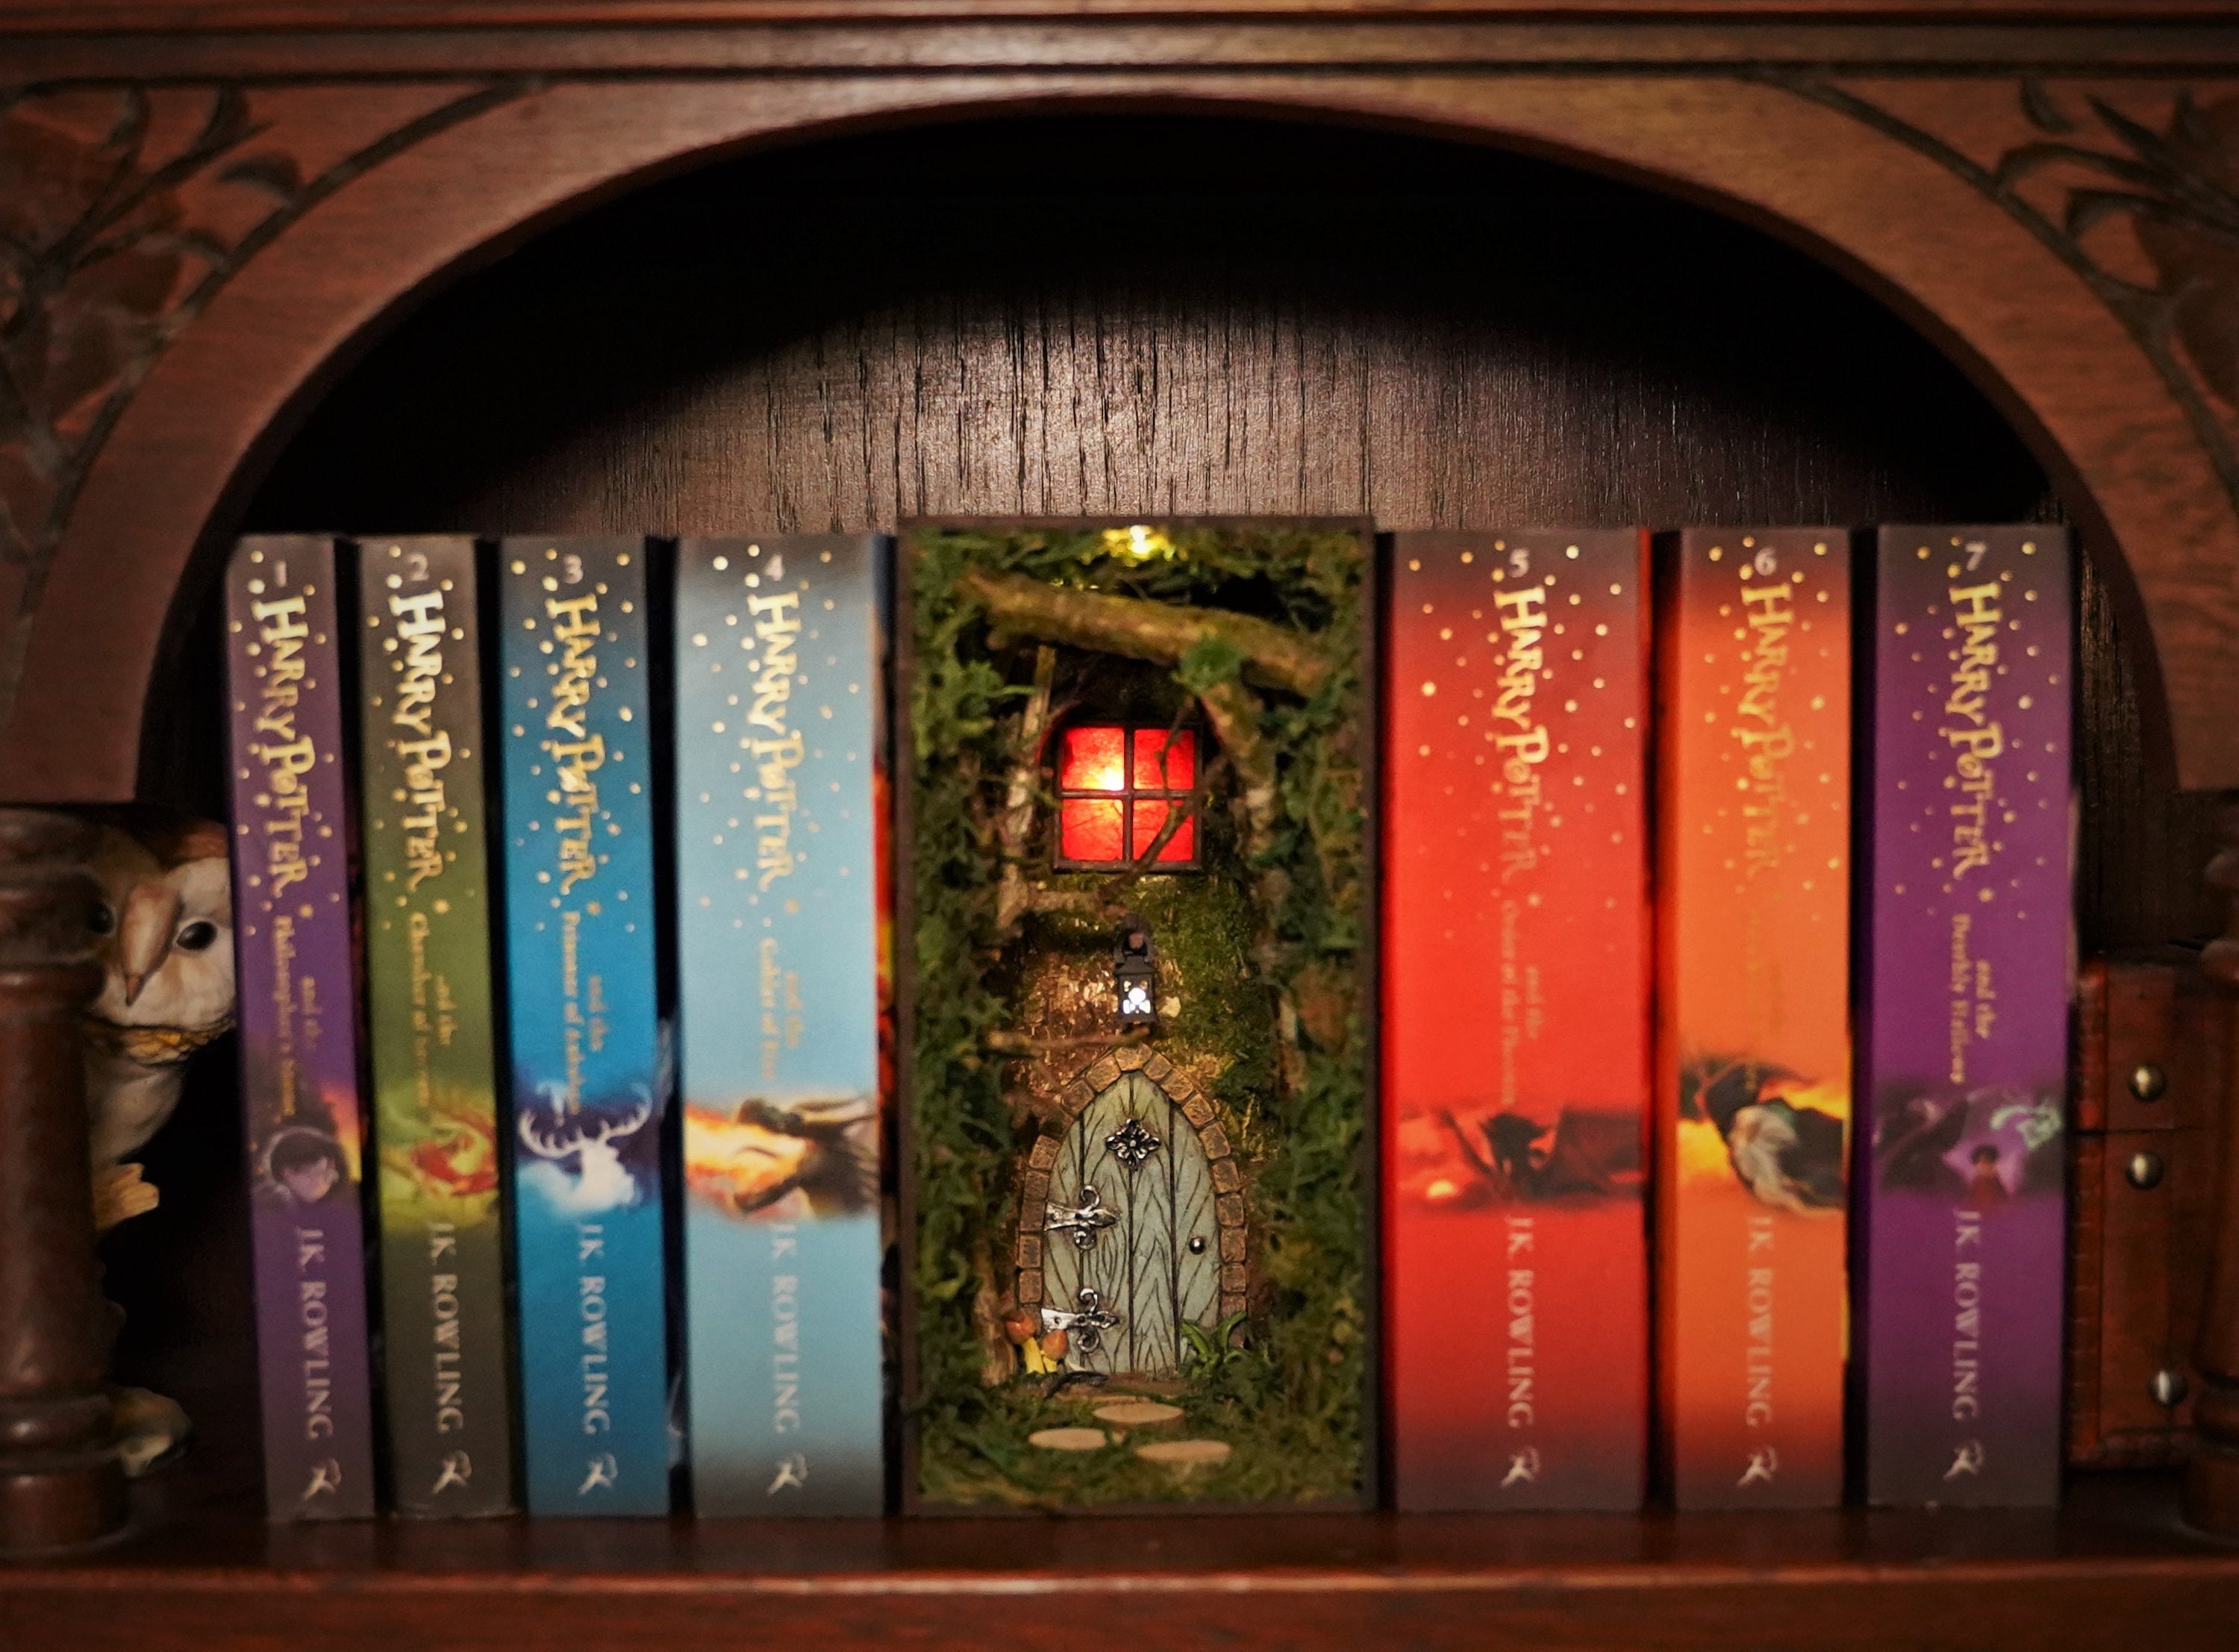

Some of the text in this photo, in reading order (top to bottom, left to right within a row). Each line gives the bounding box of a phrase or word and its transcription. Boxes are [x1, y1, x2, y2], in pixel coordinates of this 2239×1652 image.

[407, 553, 429, 582] 2
[563, 553, 584, 583] 3
[1509, 548, 1529, 578] 5
[1754, 548, 1776, 576] 6
[1964, 542, 1987, 571] 7
[1738, 583, 1793, 725] HARRY
[1945, 582, 2004, 880] HARRY POTTER
[251, 595, 316, 898] HARRY POTTER
[388, 589, 452, 893] HARRY POTTER
[545, 594, 605, 895] HARRY POTTER
[748, 591, 805, 892] HARRY POTTER
[1493, 585, 1549, 884] HARRY POTTER
[301, 1280, 334, 1439] ROWLING
[431, 1273, 463, 1433] ROWLING
[580, 1276, 610, 1436] ROWLING
[773, 1274, 801, 1434] ROWLING
[1507, 1269, 1534, 1428] ROWLING
[1746, 1268, 1773, 1428] ROWLING
[1953, 1263, 1982, 1421] ROWLING
